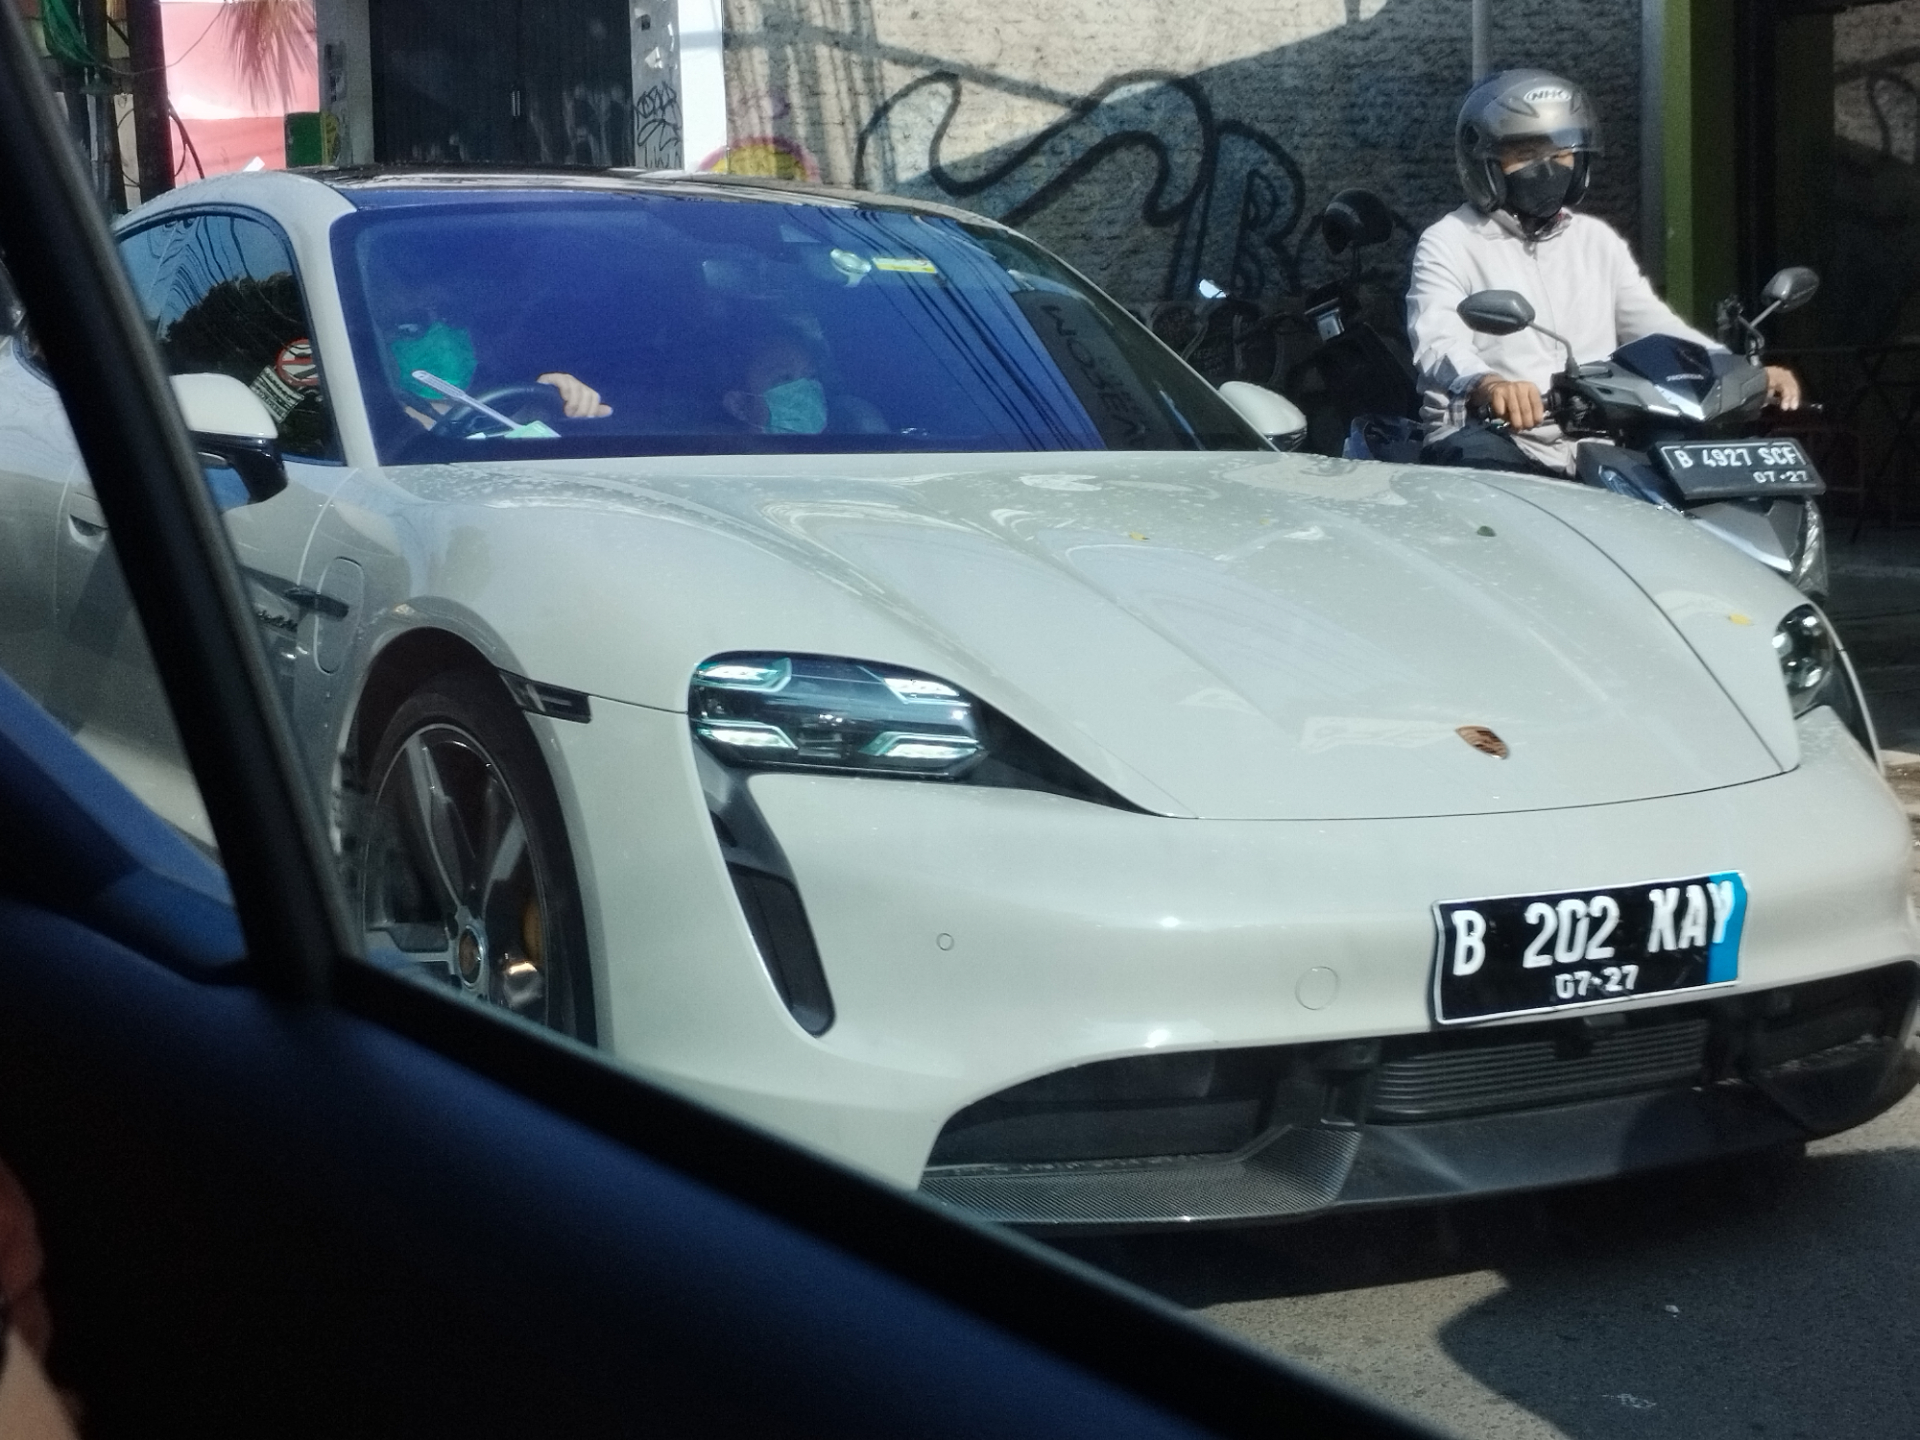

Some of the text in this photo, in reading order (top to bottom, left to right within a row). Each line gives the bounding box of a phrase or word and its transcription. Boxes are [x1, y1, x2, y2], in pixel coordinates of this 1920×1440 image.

[1674, 447, 1797, 468] B 4927 SCF
[1451, 879, 1736, 977] B 202 XAY
